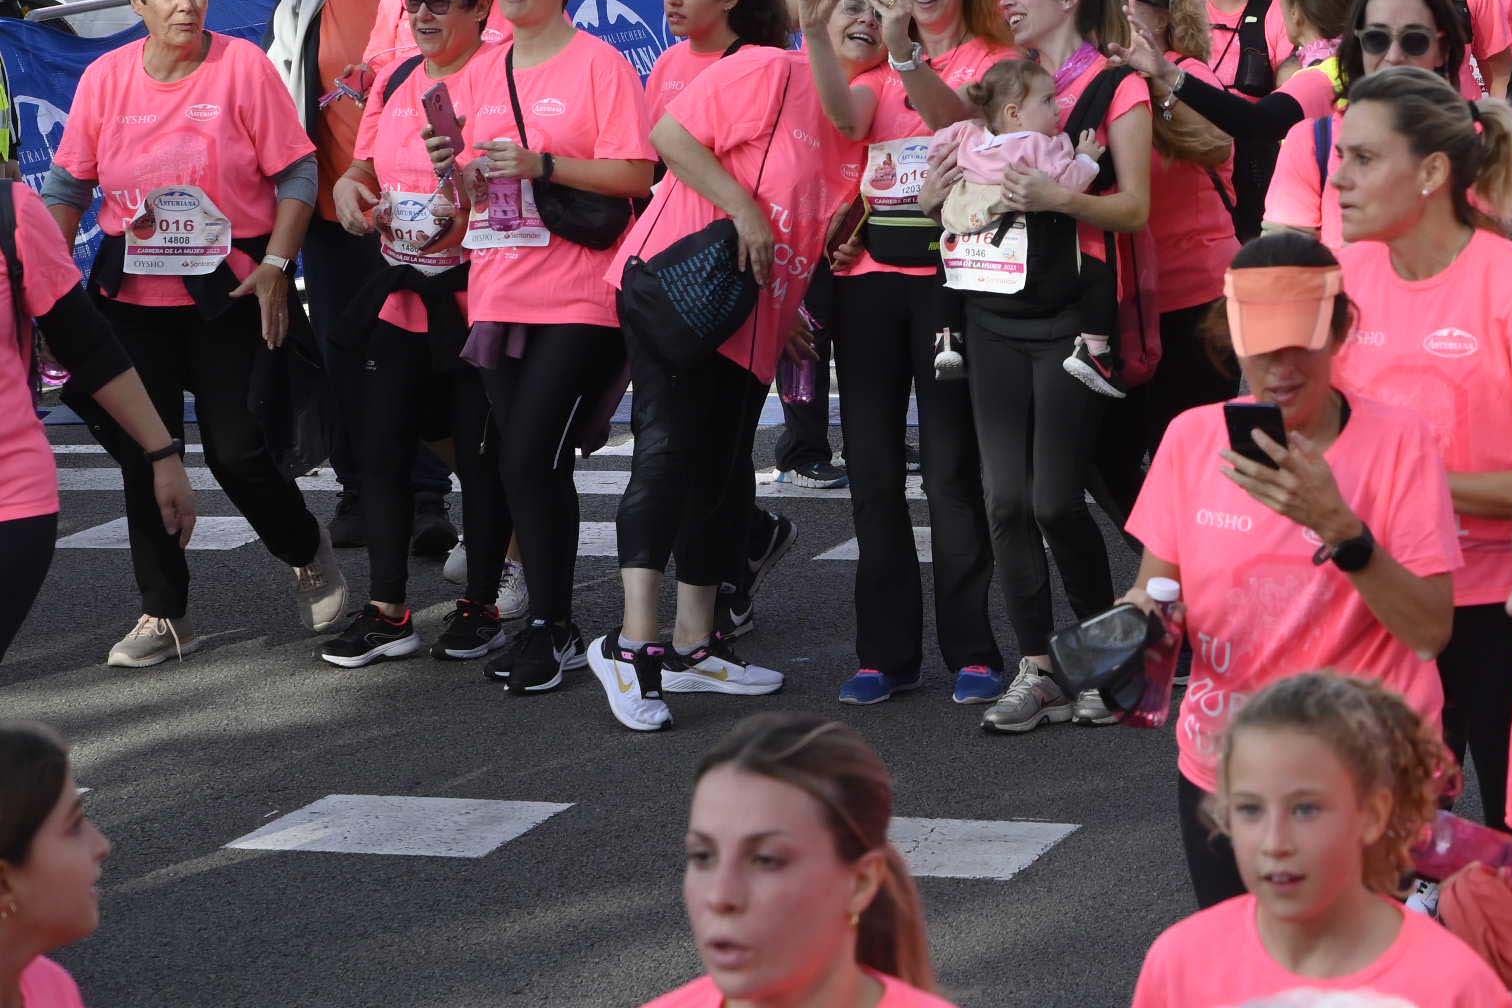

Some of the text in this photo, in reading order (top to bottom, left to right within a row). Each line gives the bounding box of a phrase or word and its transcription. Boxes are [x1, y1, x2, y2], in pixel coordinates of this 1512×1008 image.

[616, 29, 647, 42] LECHERA
[117, 114, 158, 124] OYSHO
[159, 219, 195, 232] 016
[162, 236, 191, 245] 14808
[394, 228, 424, 242] 01
[965, 247, 987, 258] 9346
[1196, 508, 1253, 533] OYSHO
